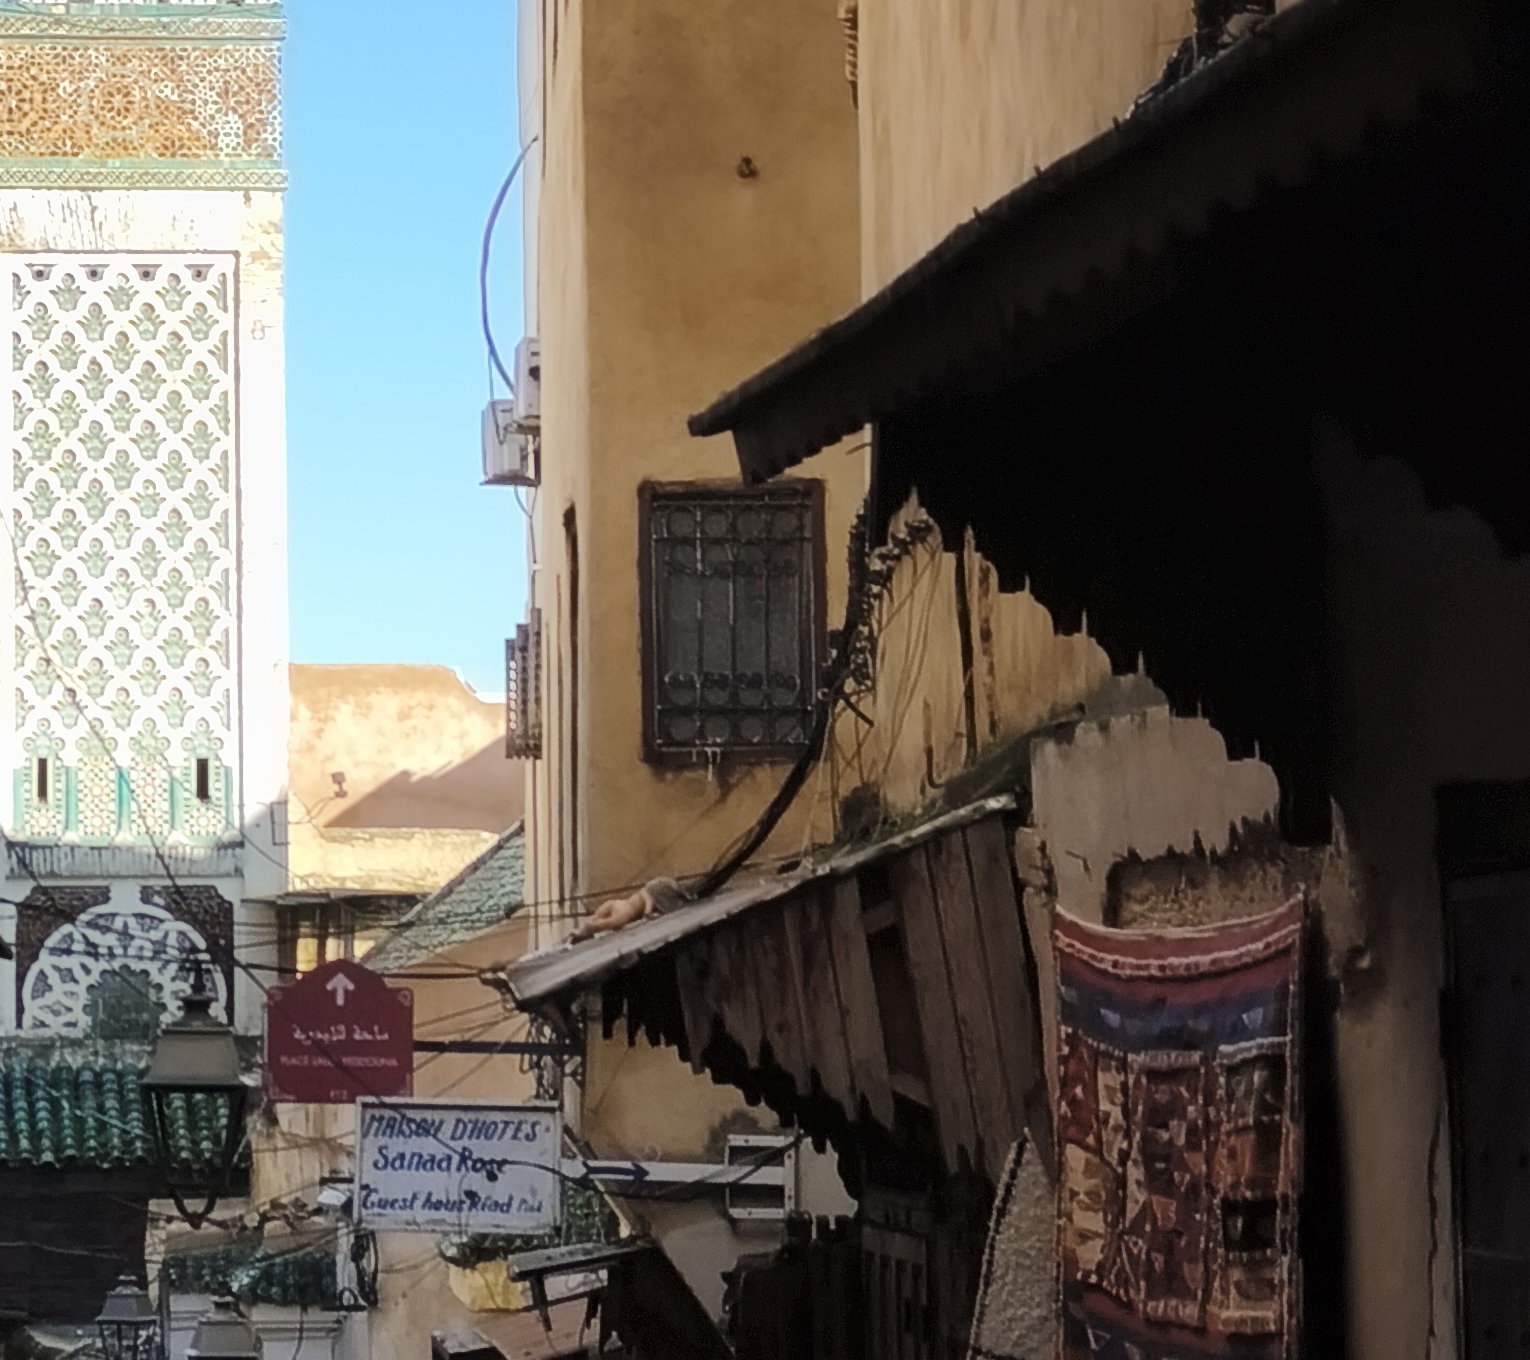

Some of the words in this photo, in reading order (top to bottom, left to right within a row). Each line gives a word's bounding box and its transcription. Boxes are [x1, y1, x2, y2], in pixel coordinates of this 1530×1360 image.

[361, 1113, 445, 1140] MAISON
[450, 1116, 542, 1142] D'HOTES
[372, 1144, 454, 1172] Sanaa
[361, 1187, 420, 1211] Guest
[465, 1190, 514, 1214] Riad
